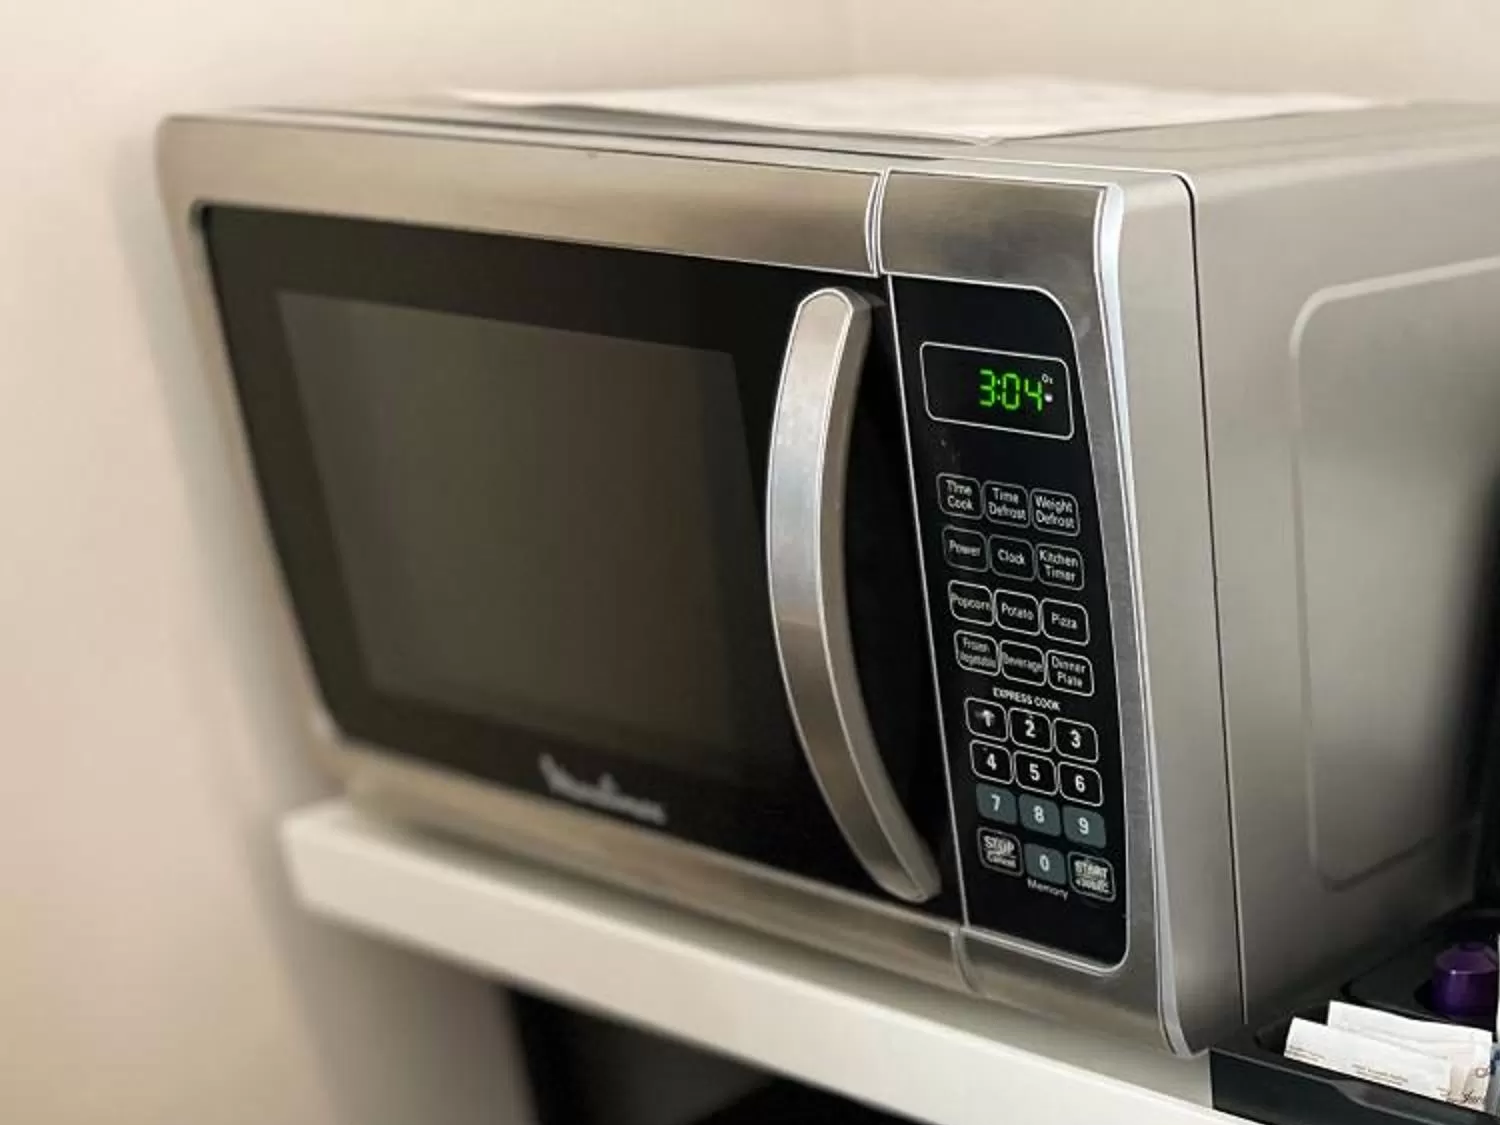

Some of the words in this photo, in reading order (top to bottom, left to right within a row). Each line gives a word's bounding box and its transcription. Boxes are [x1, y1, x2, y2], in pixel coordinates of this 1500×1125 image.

[979, 368, 1043, 411] 3:04
[945, 479, 973, 495] Time
[992, 487, 1019, 503] Time
[947, 496, 974, 511] Cook
[988, 502, 1026, 520] Defrost
[1035, 496, 1073, 513] Weight
[1036, 510, 1074, 528] Defrost
[1039, 550, 1079, 568] Kitchen
[1001, 602, 1034, 620] Potato
[1051, 612, 1078, 629] Pizza
[1057, 671, 1083, 688] Plate
[992, 687, 1033, 705] EXPRESS
[1034, 697, 1060, 712] COOK
[1025, 719, 1036, 738] 2
[1070, 729, 1081, 748] 3
[986, 753, 997, 771] 4
[1029, 763, 1040, 781] 5
[1075, 775, 1085, 793] 6
[991, 794, 1000, 811] 7
[1033, 805, 1045, 824] 8
[1078, 817, 1089, 835] 9
[1039, 854, 1050, 872] 0
[1027, 877, 1068, 901] Memory
